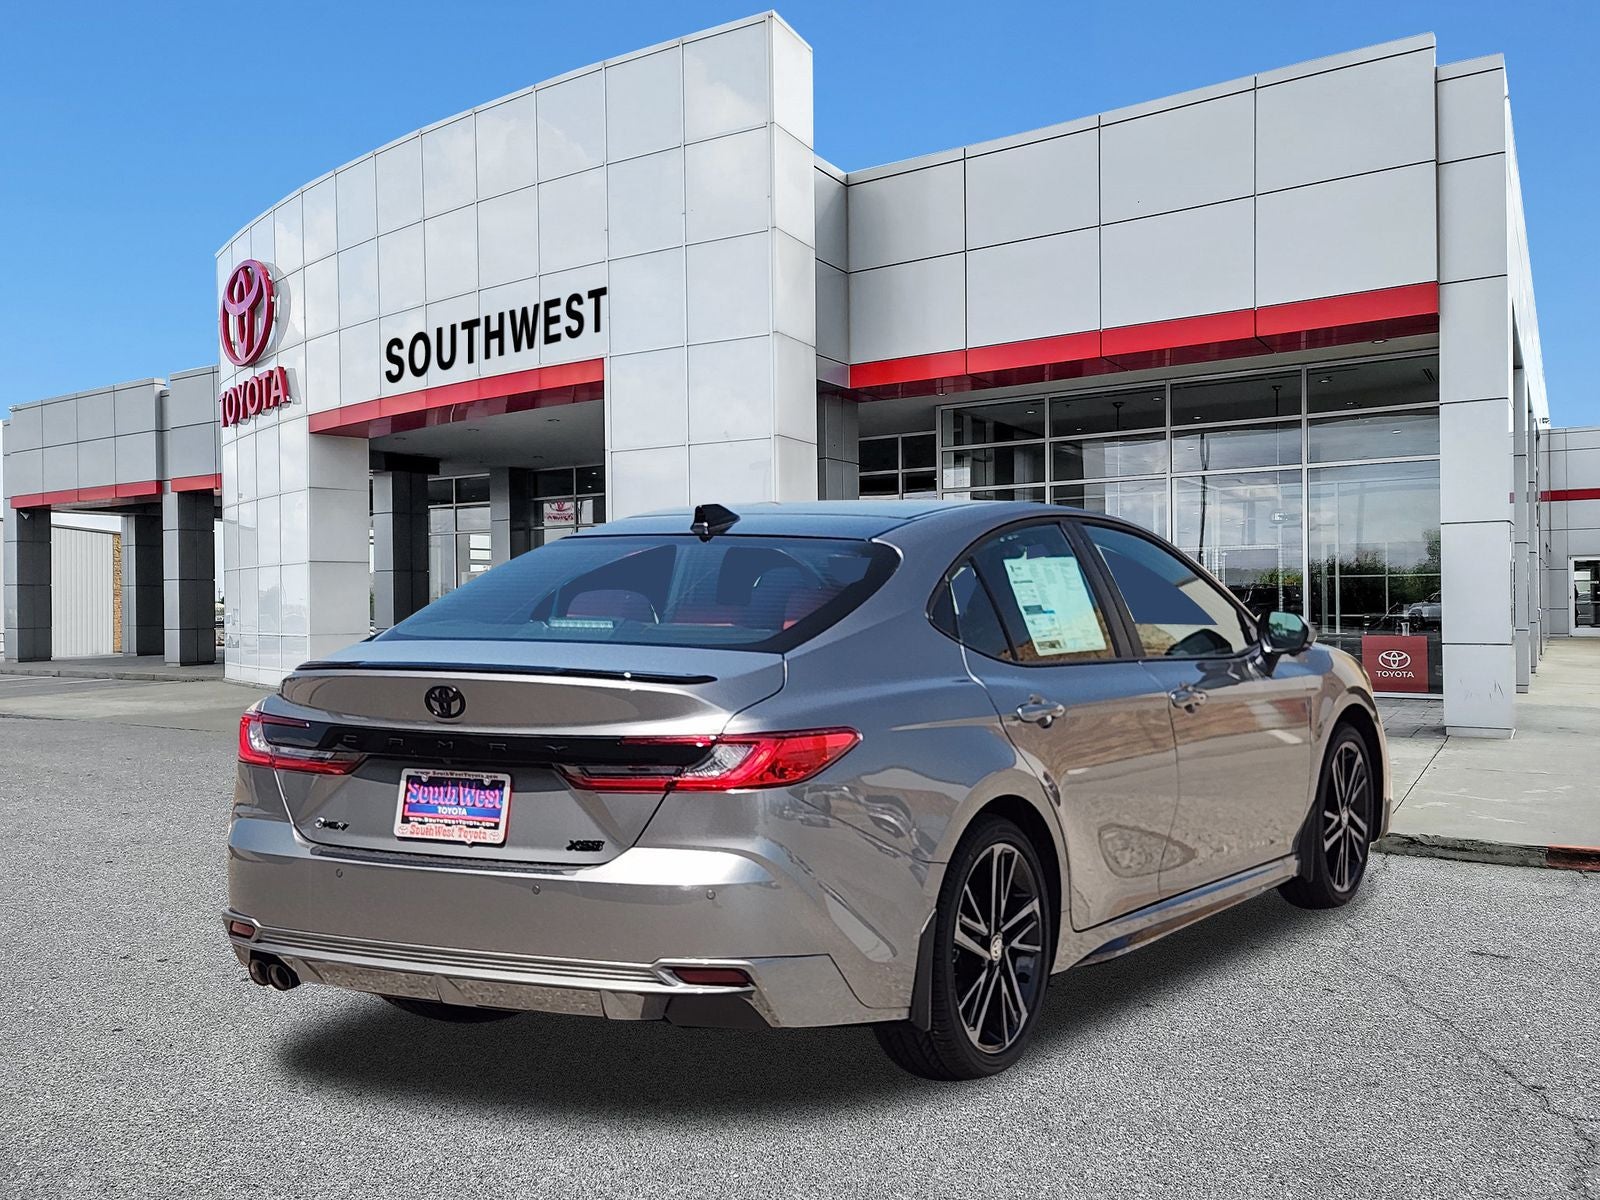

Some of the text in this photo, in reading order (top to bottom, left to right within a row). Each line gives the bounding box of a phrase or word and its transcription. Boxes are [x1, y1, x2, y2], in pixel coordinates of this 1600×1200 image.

[385, 286, 608, 384] SOUTHWEST
[217, 366, 291, 428] TOYOTA
[1376, 670, 1415, 678] TOYOTA
[437, 806, 467, 815] TOYOTA
[458, 828, 487, 841] Toyota
